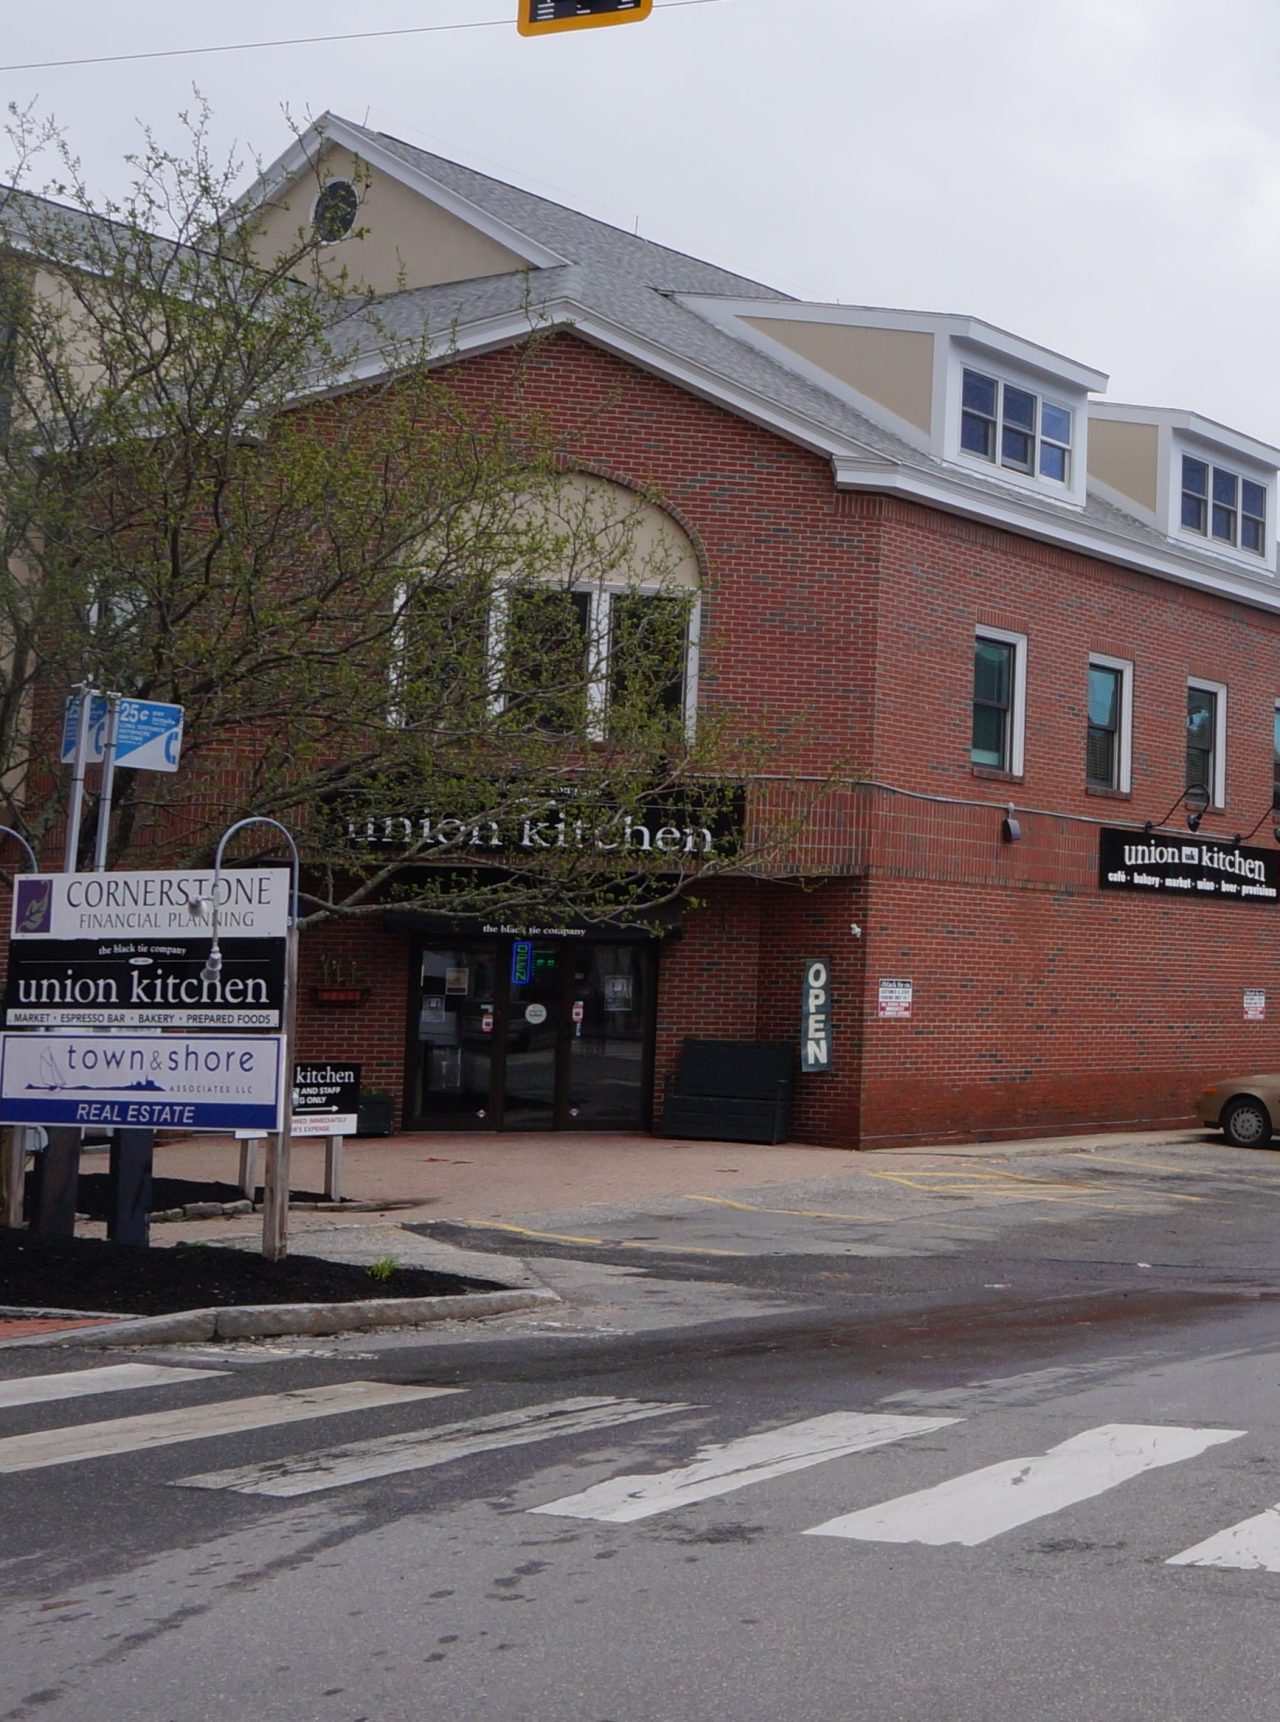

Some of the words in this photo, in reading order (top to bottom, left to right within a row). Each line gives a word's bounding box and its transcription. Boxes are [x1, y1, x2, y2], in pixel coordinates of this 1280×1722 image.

[1124, 839, 1179, 865] union
[1201, 845, 1266, 882] kitchen
[1133, 871, 1160, 888] bakery
[1165, 876, 1191, 889] market
[66, 877, 271, 908] CORNERSTONE
[79, 912, 161, 929] FINANCIAL
[168, 911, 255, 928] PLANNING
[483, 924, 498, 933] the
[529, 925, 541, 935] tie
[543, 927, 586, 936] company
[98, 945, 112, 955] the
[113, 943, 136, 954] black
[137, 943, 149, 953] tie
[150, 945, 187, 956] company
[18, 969, 120, 1003] union
[129, 968, 270, 1003] kitchen
[14, 1013, 50, 1023] MARKET
[60, 1013, 104, 1023] ESPRESSO
[107, 1013, 125, 1023] BAR
[138, 1013, 174, 1024] BAKERY
[186, 1014, 234, 1024] PREPARED
[237, 1014, 271, 1024] FOODS
[806, 963, 828, 1065] OPEN
[295, 1065, 355, 1083] kitchen
[169, 1085, 230, 1093] ASSOCIATES
[236, 1085, 252, 1094] LLC
[301, 1087, 318, 1095] AND
[306, 1096, 327, 1104] ONLY
[76, 1104, 122, 1121] REAL
[126, 1105, 195, 1123] ESTATE
